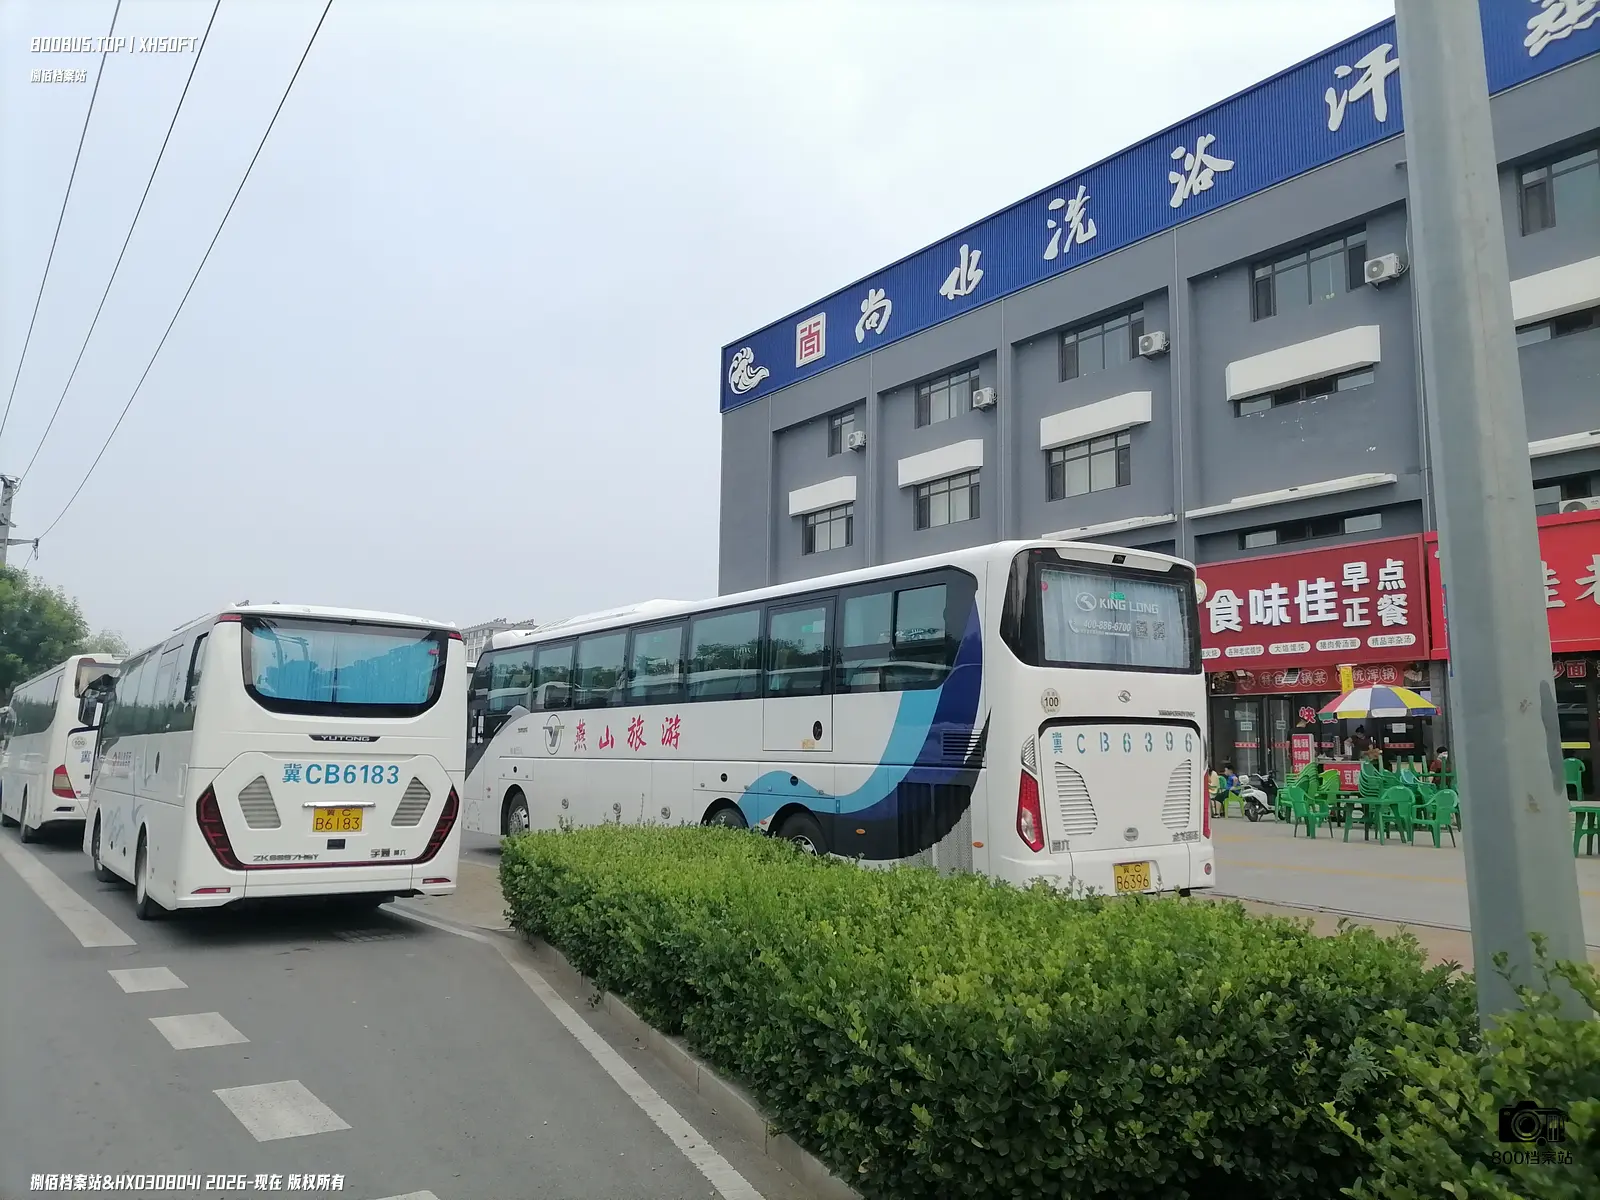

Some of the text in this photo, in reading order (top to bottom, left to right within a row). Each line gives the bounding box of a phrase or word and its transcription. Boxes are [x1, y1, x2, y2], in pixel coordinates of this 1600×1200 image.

[1342, 558, 1406, 592] 早点
[1100, 598, 1159, 614] KING LONG
[1205, 577, 1340, 634] 食味佳
[1342, 593, 1409, 627] 正餐
[1083, 619, 1131, 632] 400-886-6700
[1044, 697, 1059, 707] 100
[321, 735, 370, 743] YUTONG
[573, 714, 682, 752] 燕山旅游
[282, 762, 399, 785] 冀CB6183
[316, 817, 360, 831] B6183
[1116, 874, 1149, 891] B6396
